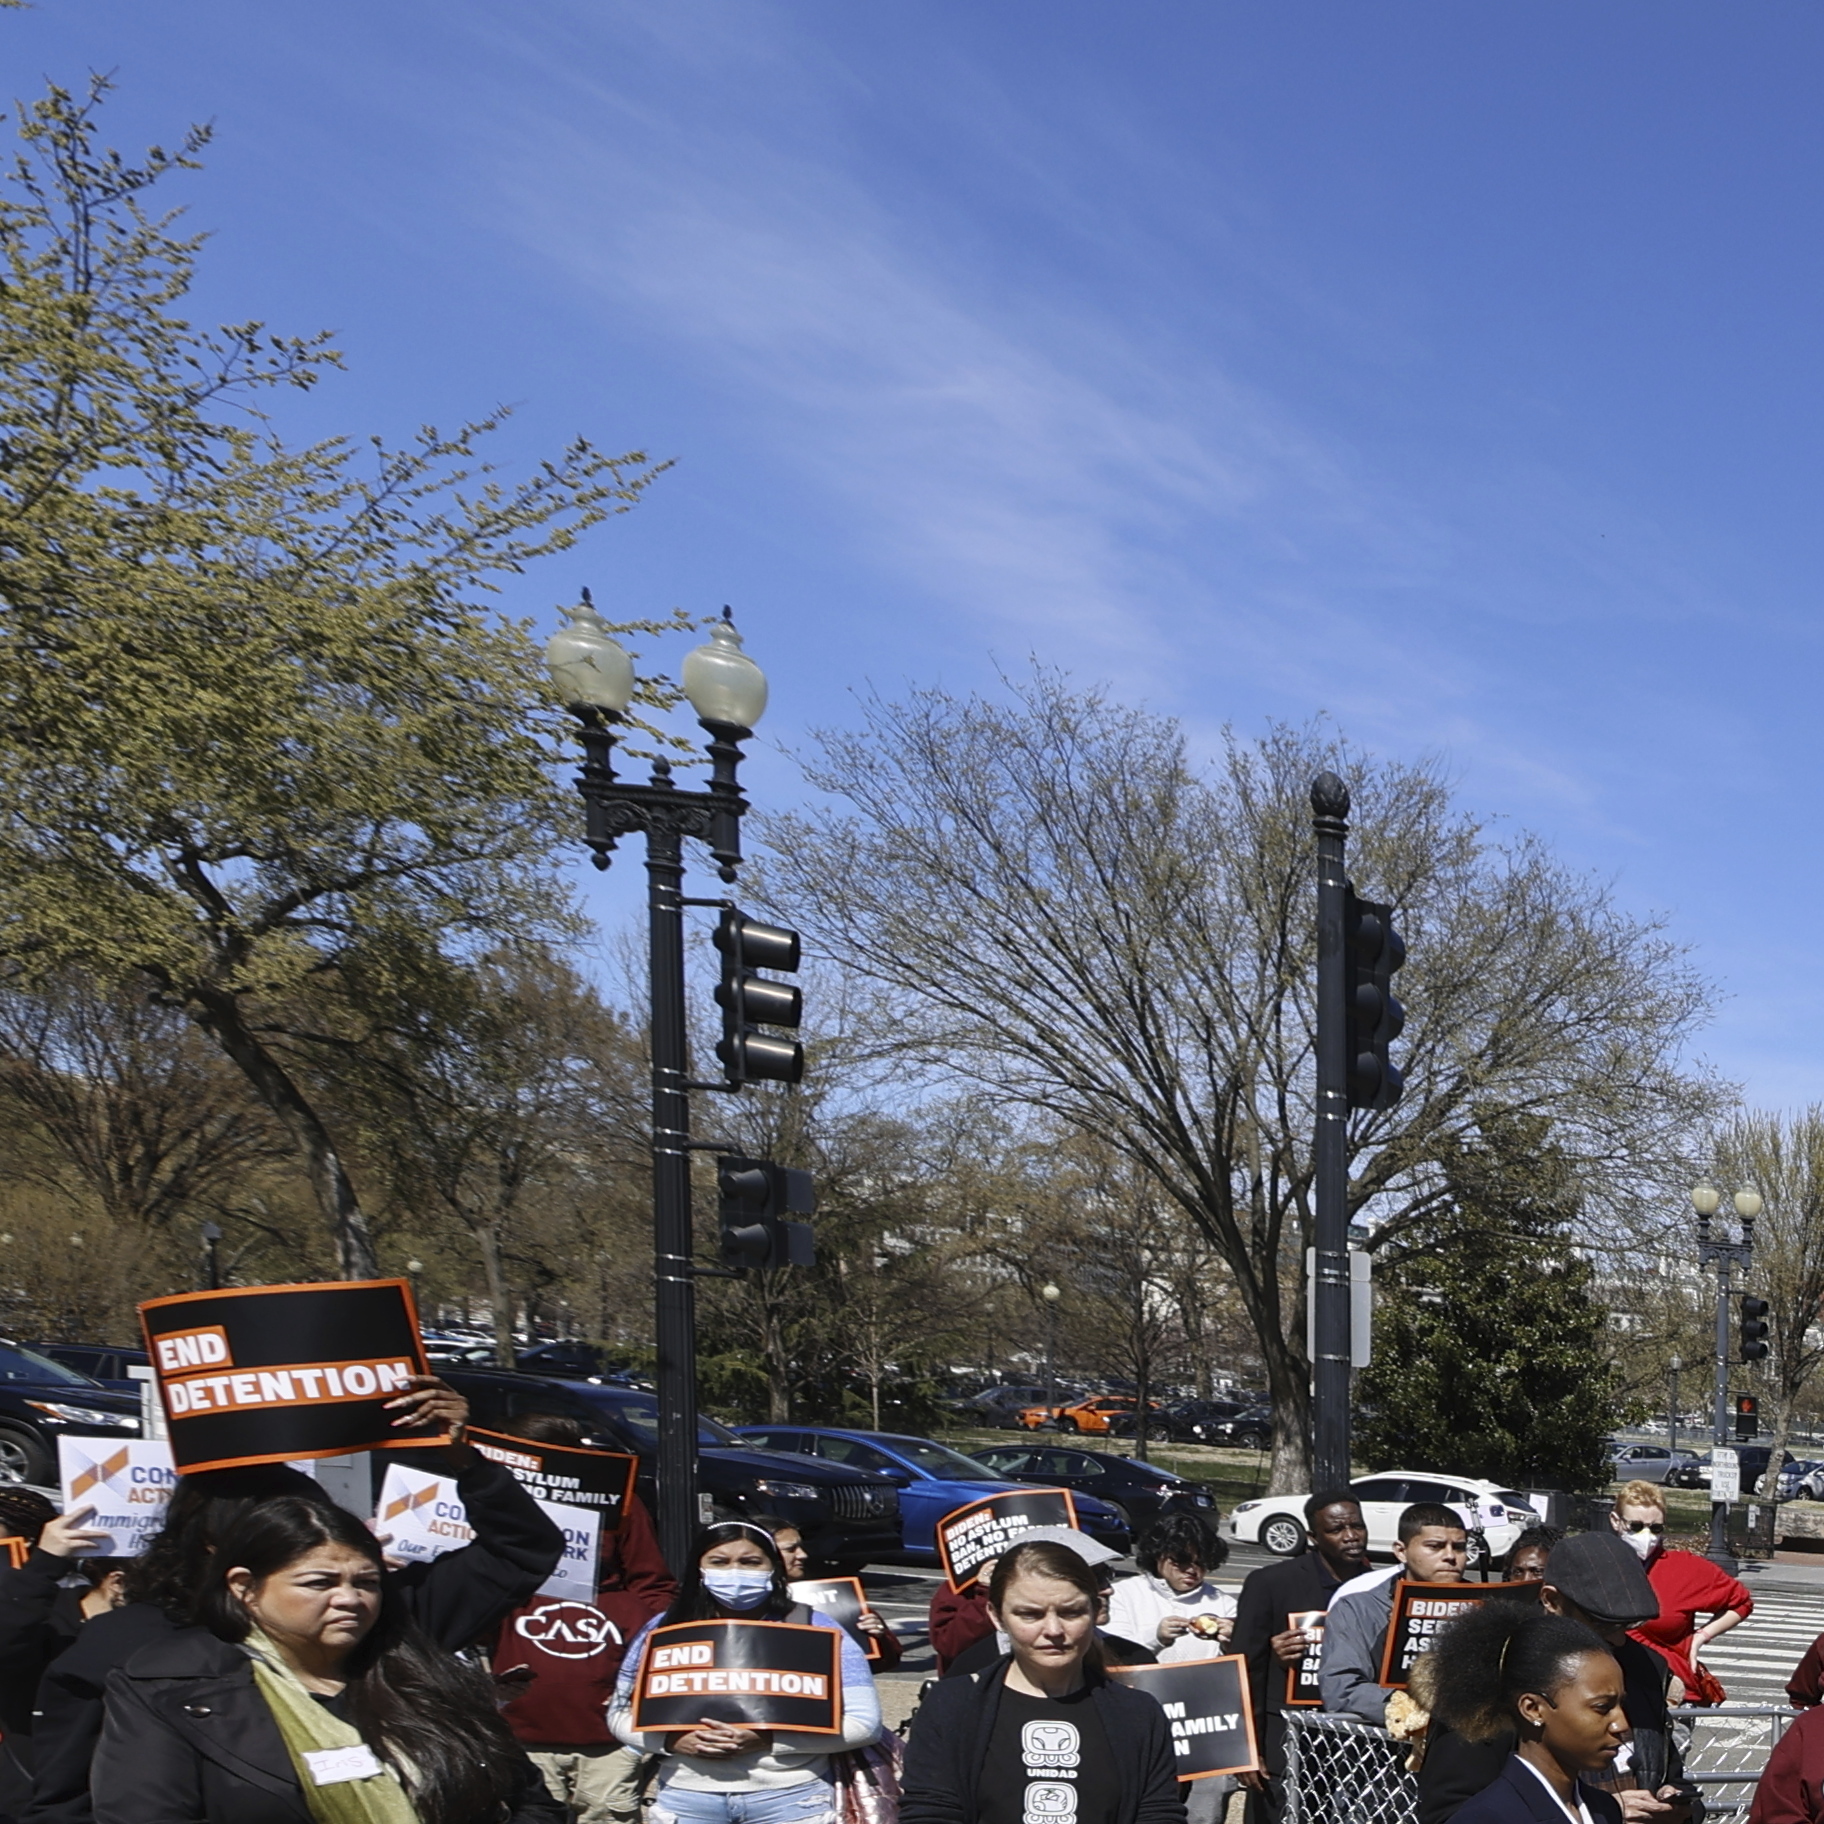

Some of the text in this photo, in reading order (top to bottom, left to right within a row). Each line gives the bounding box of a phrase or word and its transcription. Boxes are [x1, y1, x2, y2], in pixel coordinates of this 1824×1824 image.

[157, 1333, 227, 1370] END
[167, 1362, 411, 1413] DETENTION
[508, 1465, 580, 1489] SYLUM
[552, 1489, 622, 1506] FAMILY
[945, 1512, 990, 1540] BIDEN:
[949, 1537, 966, 1550] NO
[967, 1515, 1029, 1543] ASYLUM
[951, 1543, 981, 1564] BAN,
[982, 1530, 1005, 1546] NO
[515, 1615, 623, 1645] CASA
[654, 1645, 711, 1668] END
[650, 1672, 823, 1695] DETENTION
[1027, 1769, 1078, 1779] UNIDAD
